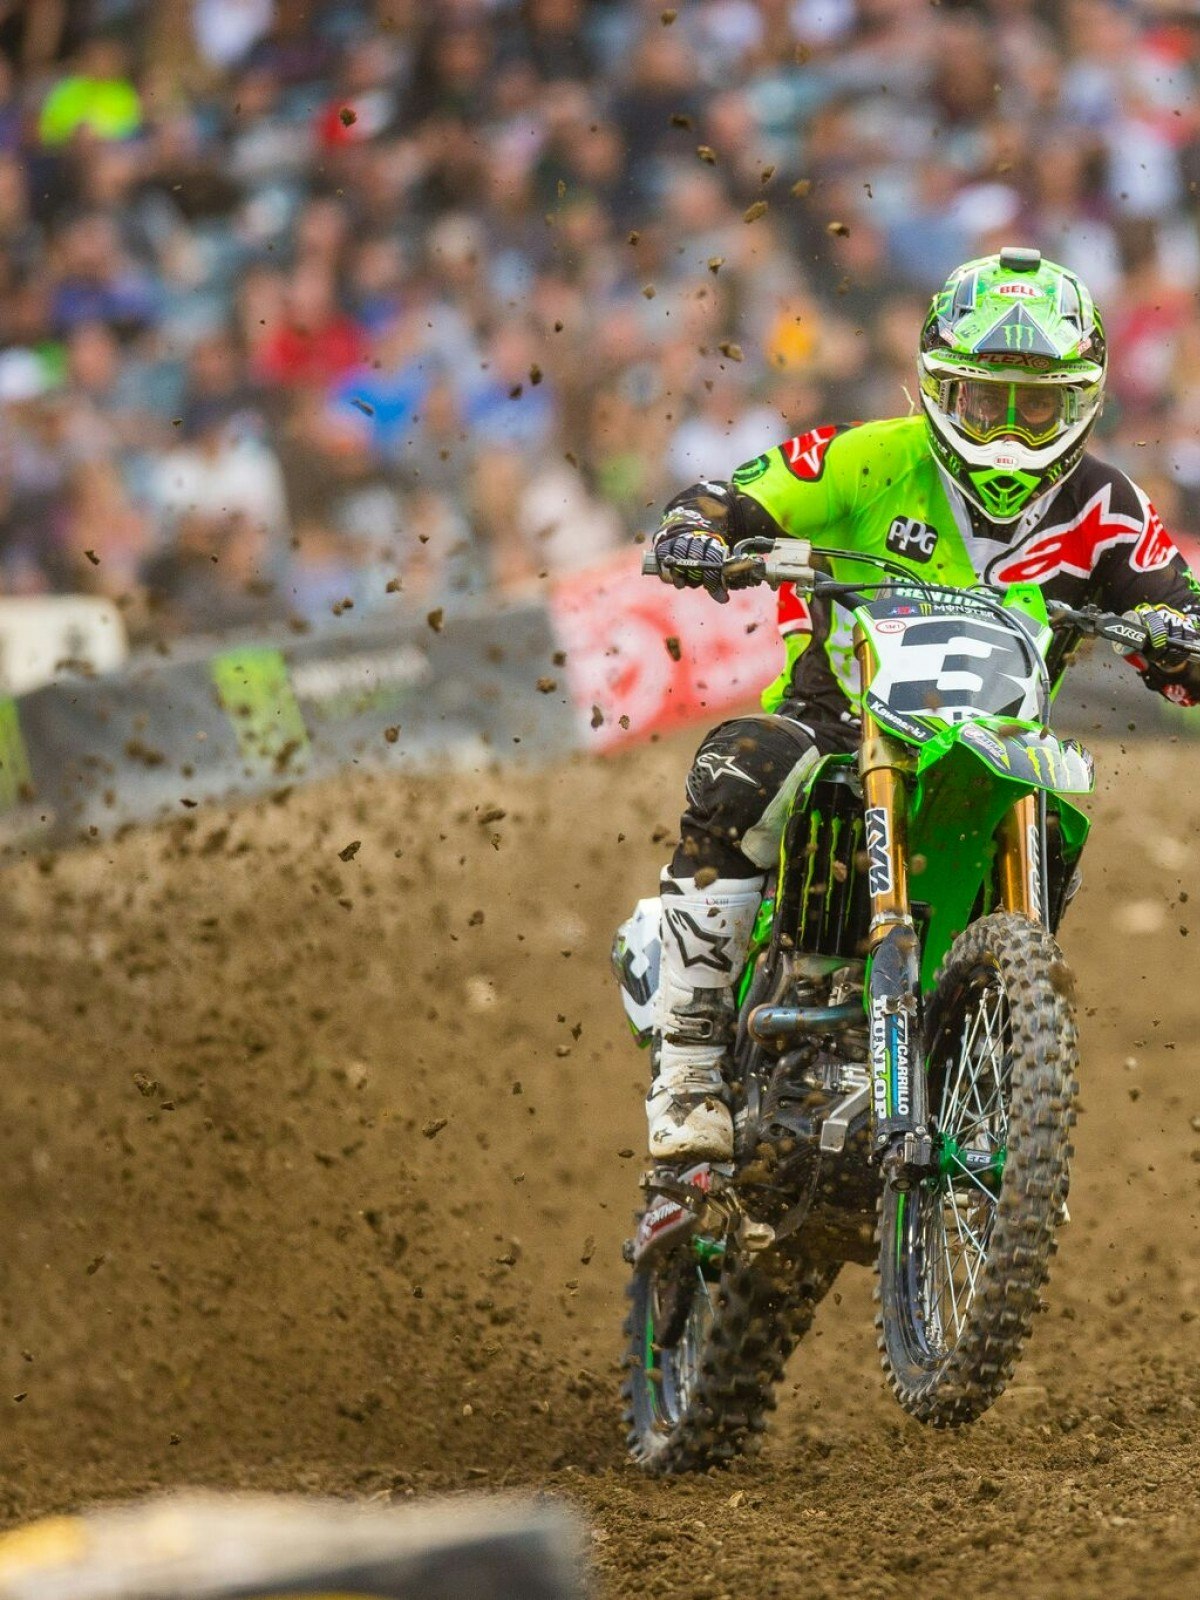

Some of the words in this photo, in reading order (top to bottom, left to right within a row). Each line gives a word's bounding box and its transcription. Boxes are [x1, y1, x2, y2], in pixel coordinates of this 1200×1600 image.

[1000, 284, 1036, 297] BELL
[888, 518, 937, 555] PPG
[1104, 624, 1147, 643] ARC
[888, 620, 1033, 715] 3
[870, 700, 927, 739] Kawasaki
[872, 995, 888, 1119] DUNLOP
[897, 1044, 910, 1116] CARRILLO
